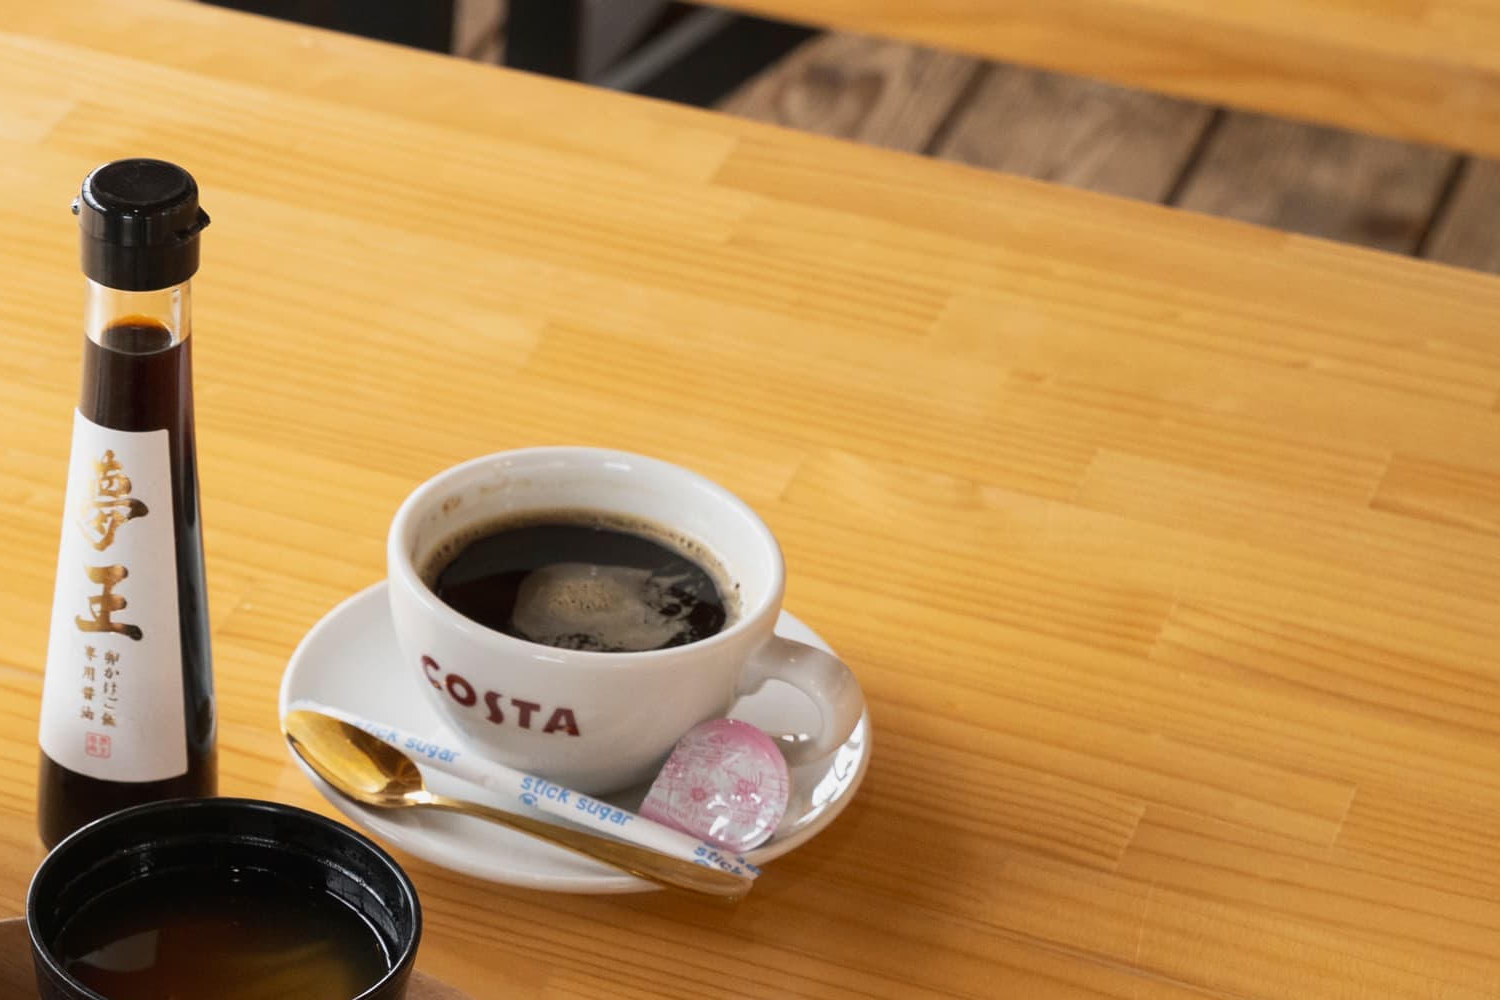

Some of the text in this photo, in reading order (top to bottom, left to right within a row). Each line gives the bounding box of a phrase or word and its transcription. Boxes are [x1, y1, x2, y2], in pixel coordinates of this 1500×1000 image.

[421, 655, 580, 737] COSTA
[405, 737, 460, 762] sugar
[521, 776, 571, 804] stick
[576, 797, 634, 826] sugar
